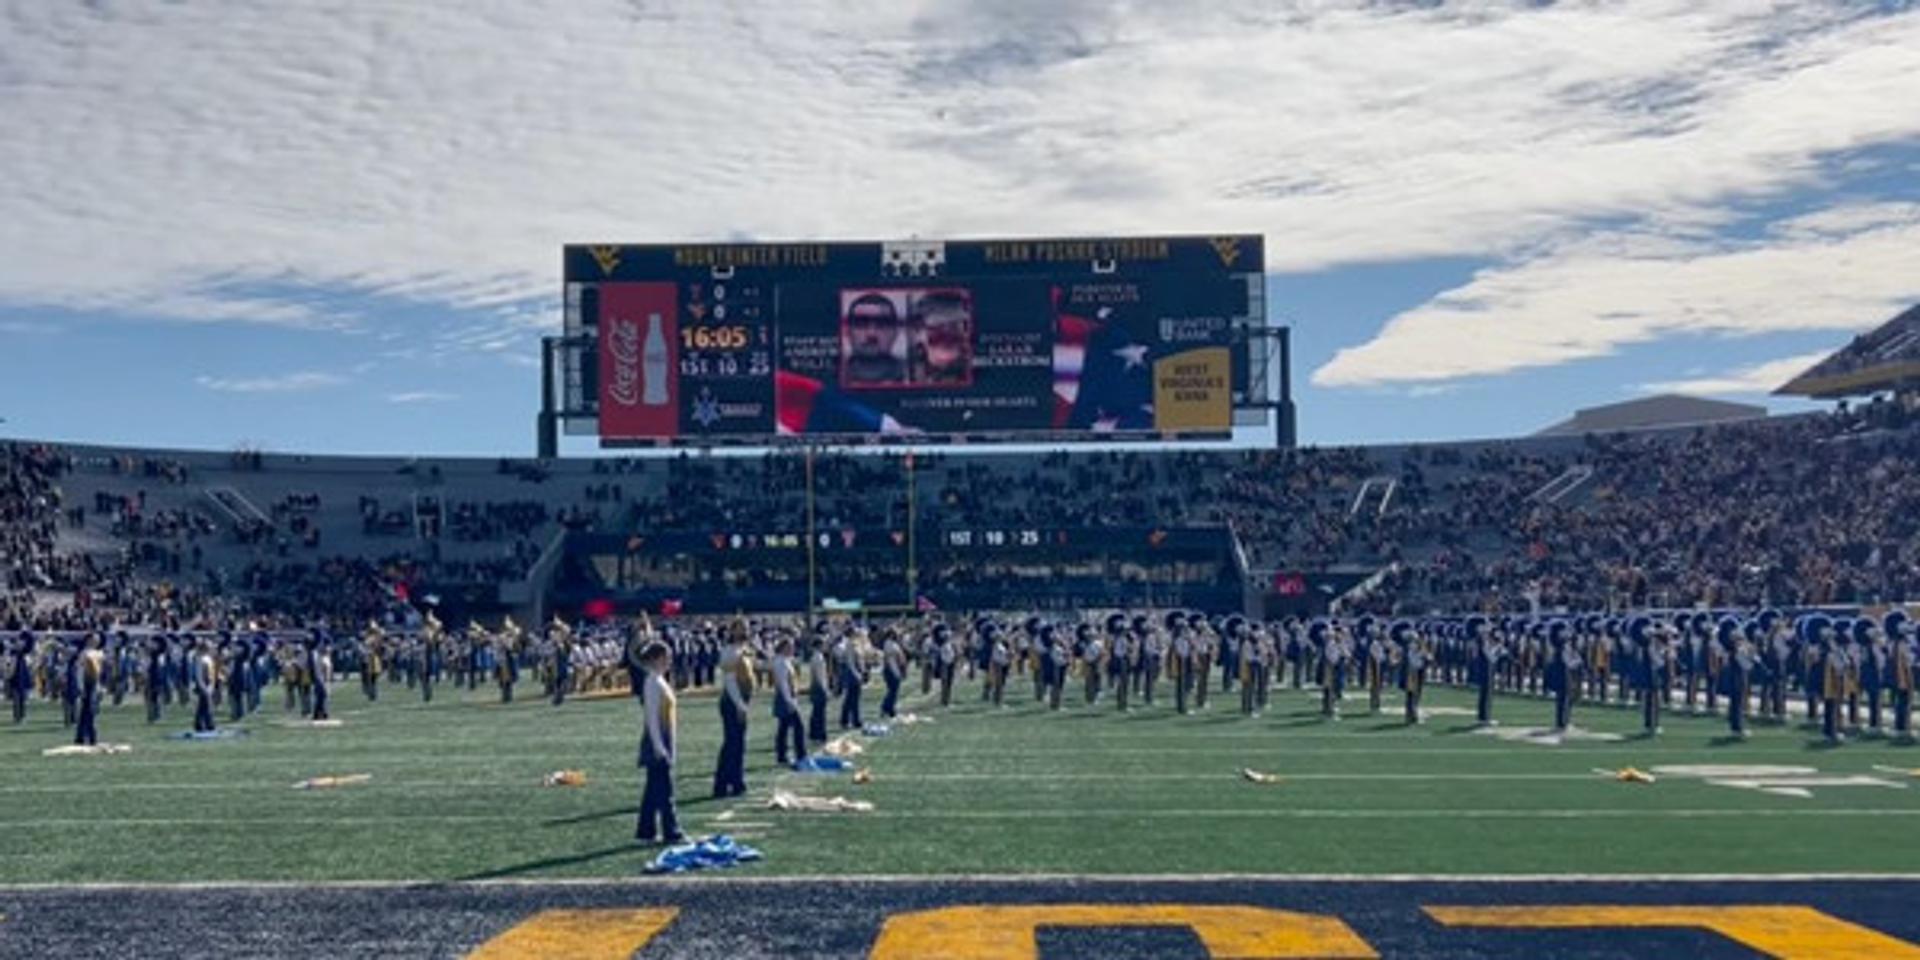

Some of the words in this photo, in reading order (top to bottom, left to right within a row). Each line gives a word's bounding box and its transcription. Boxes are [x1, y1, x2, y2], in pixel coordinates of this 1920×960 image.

[783, 245, 827, 265] FIELD
[1173, 318, 1226, 330] UNITED
[681, 326, 749, 348] 16:05
[719, 358, 738, 376] 10
[748, 358, 769, 376] 25
[949, 530, 972, 546] 1ST
[985, 530, 1004, 546] 10
[1020, 530, 1039, 546] 25
